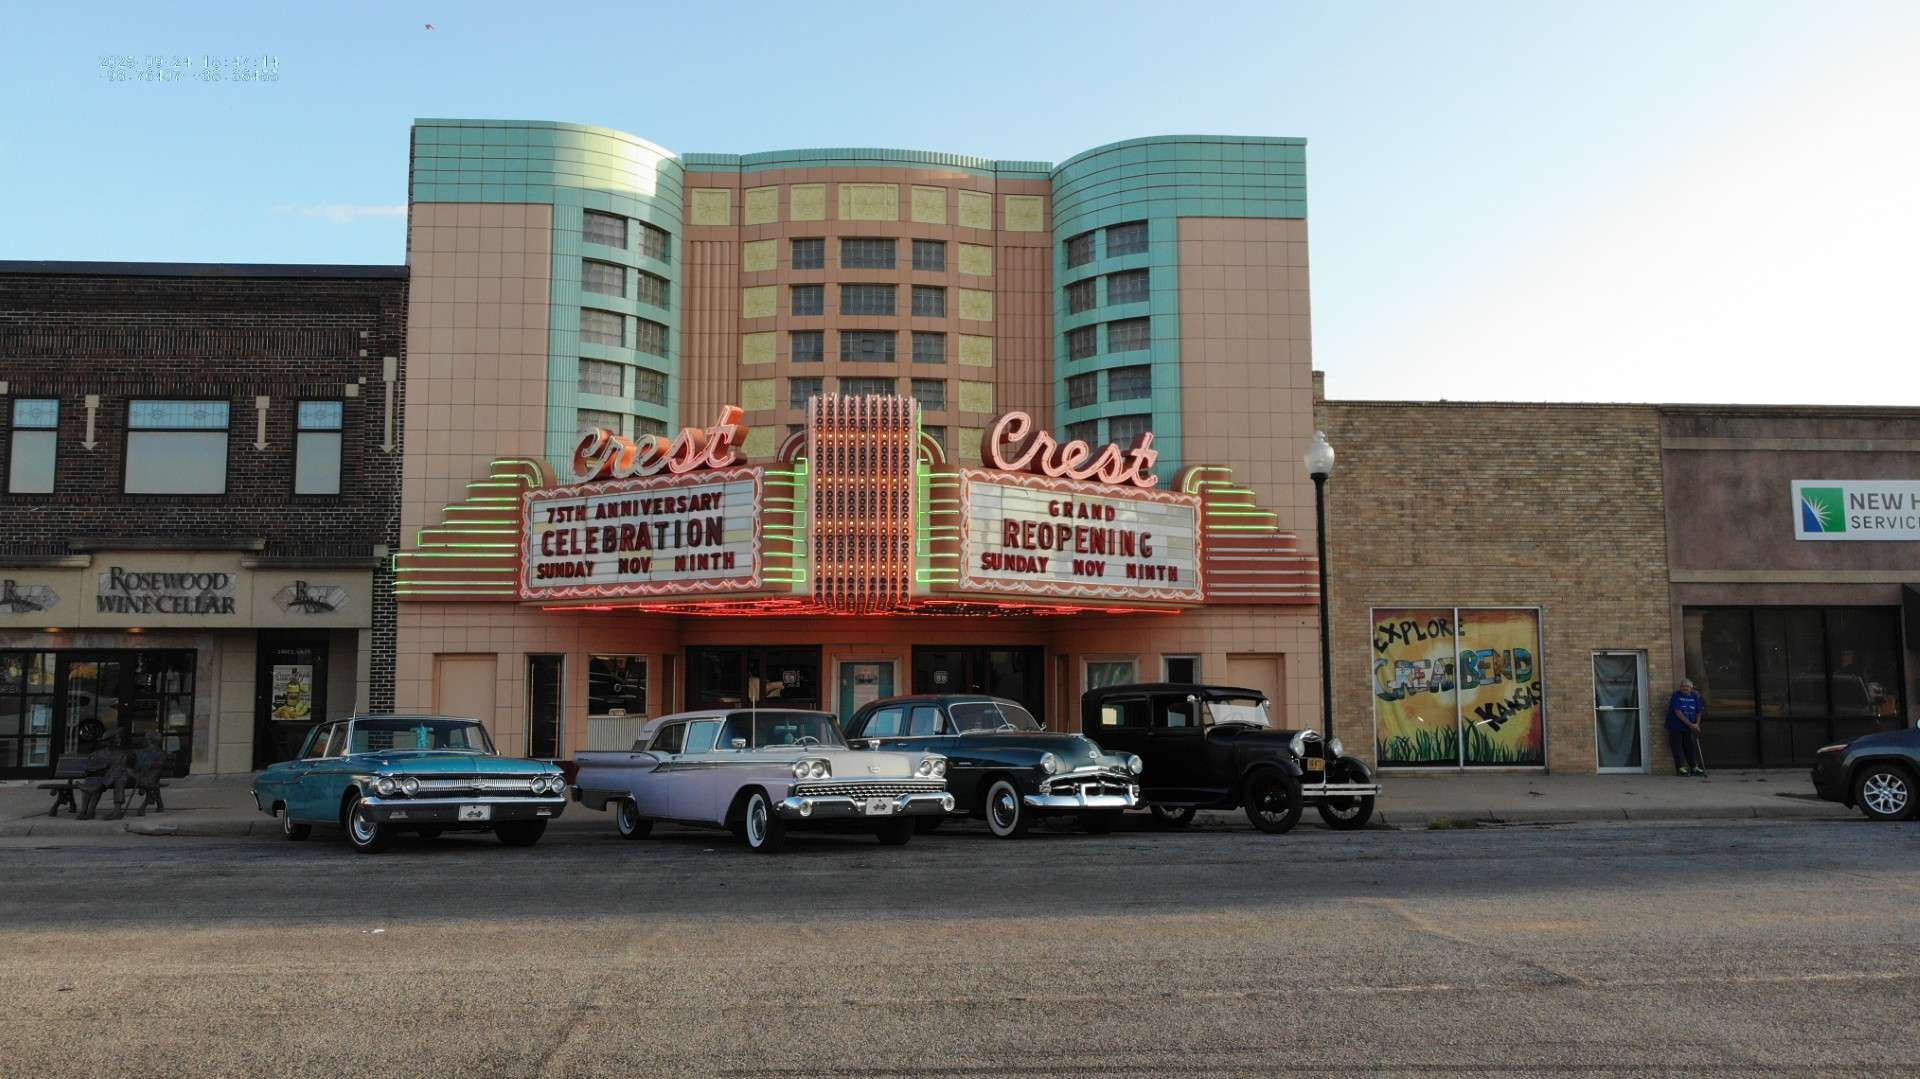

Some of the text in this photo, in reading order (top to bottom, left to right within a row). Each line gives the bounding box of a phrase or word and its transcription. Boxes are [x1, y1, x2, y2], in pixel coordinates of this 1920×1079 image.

[571, 405, 749, 483] Crest
[984, 411, 1159, 488] Crest
[546, 492, 722, 524] 75TH ANNIVERSARY
[1048, 500, 1116, 522] GRAND
[1850, 493, 1903, 510] NEW
[541, 516, 723, 557] CELEBRATION
[1851, 515, 1920, 529] SERVIC
[1003, 518, 1153, 559] REOPENING
[536, 551, 735, 580] SUNDAY NOV NINTH
[980, 552, 1178, 582] SUNDAY NOV NINTH
[110, 566, 229, 598] ROSEWOOD
[96, 595, 236, 614] WINE CELLAR
[1373, 618, 1465, 654] EXPLORE
[1459, 648, 1533, 690] BEND
[1474, 681, 1542, 732] KANSAS
